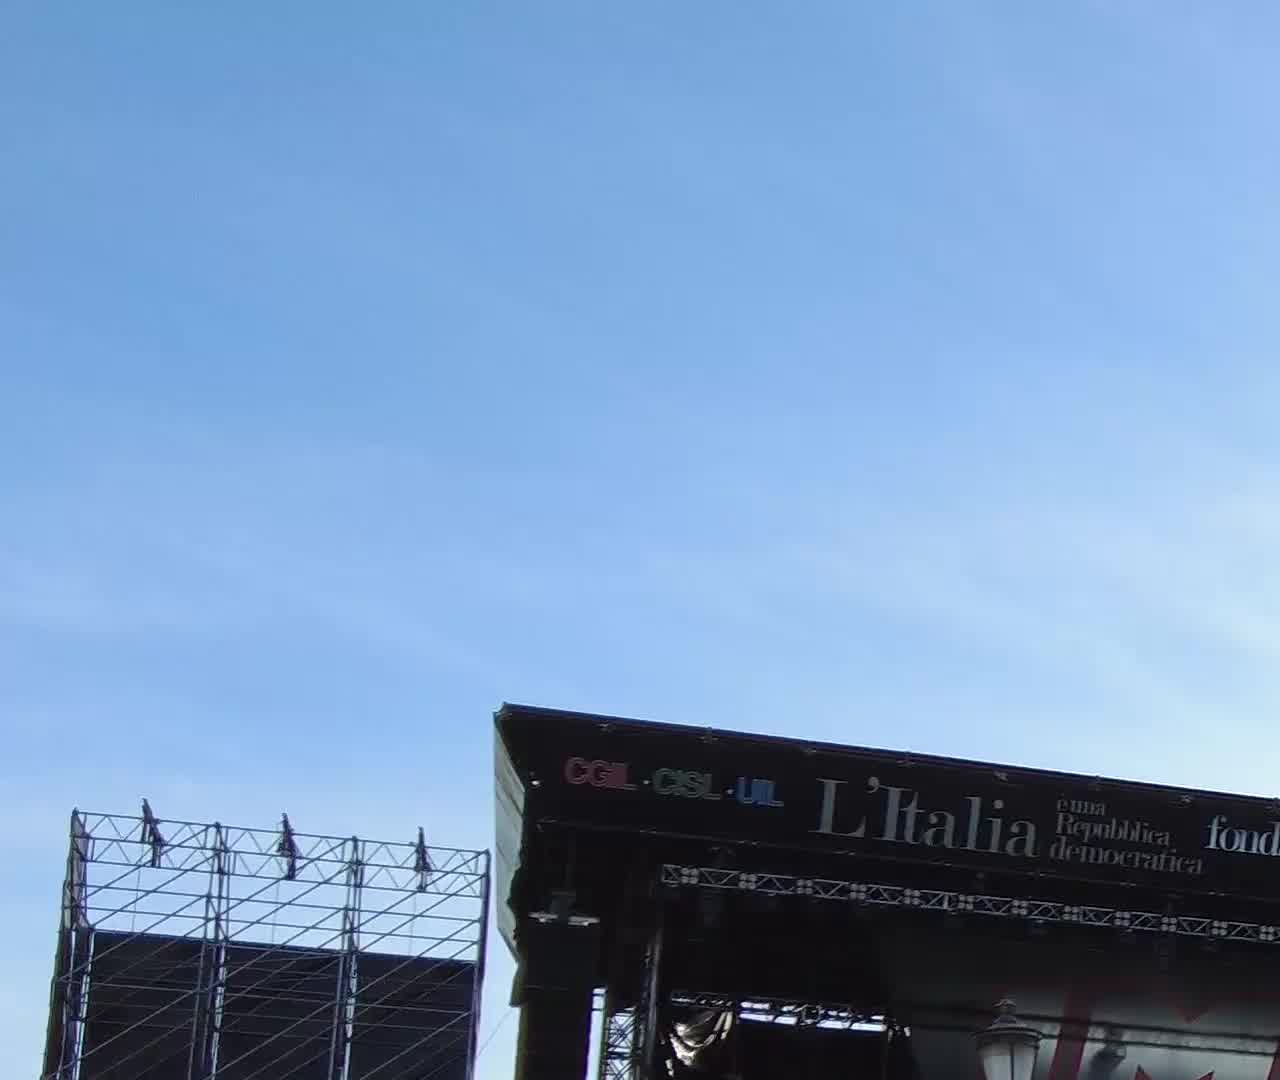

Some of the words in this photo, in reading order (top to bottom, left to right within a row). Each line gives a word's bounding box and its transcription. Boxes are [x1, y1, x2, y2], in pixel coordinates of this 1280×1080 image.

[565, 756, 639, 792] CGIL
[654, 767, 723, 801] CISL
[736, 776, 784, 807] UIL
[810, 776, 1042, 860] L'Italia
[1055, 812, 1170, 848] Repubblica
[1050, 835, 1204, 875] democratica
